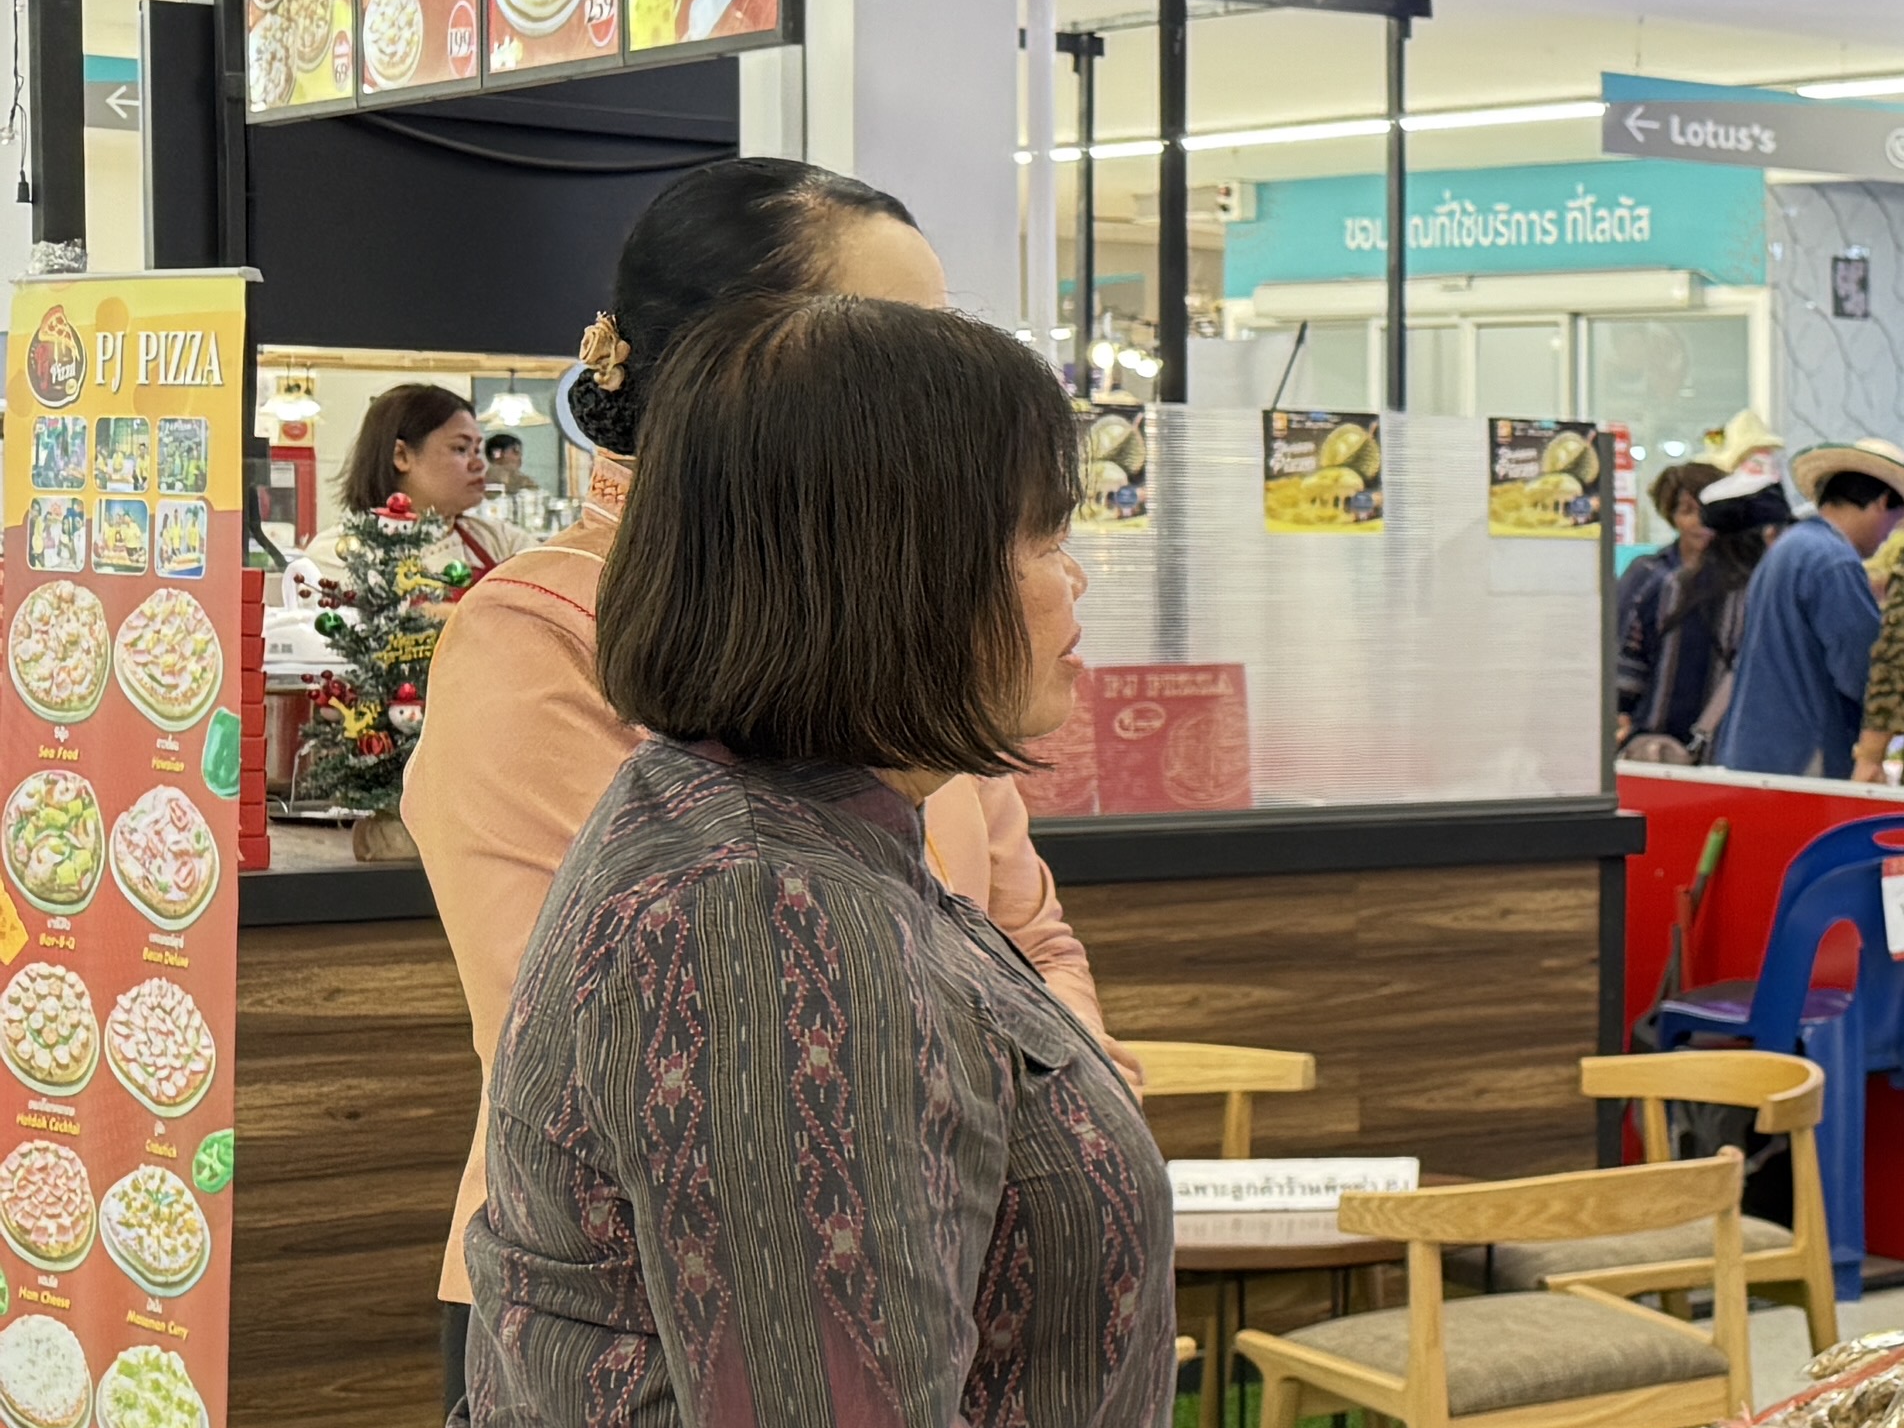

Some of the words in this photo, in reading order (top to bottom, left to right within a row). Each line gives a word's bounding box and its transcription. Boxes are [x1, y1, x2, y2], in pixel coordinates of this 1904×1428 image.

[1669, 113, 1778, 156] Lotus's
[95, 330, 127, 394] PJ
[136, 330, 225, 387] PIZZA
